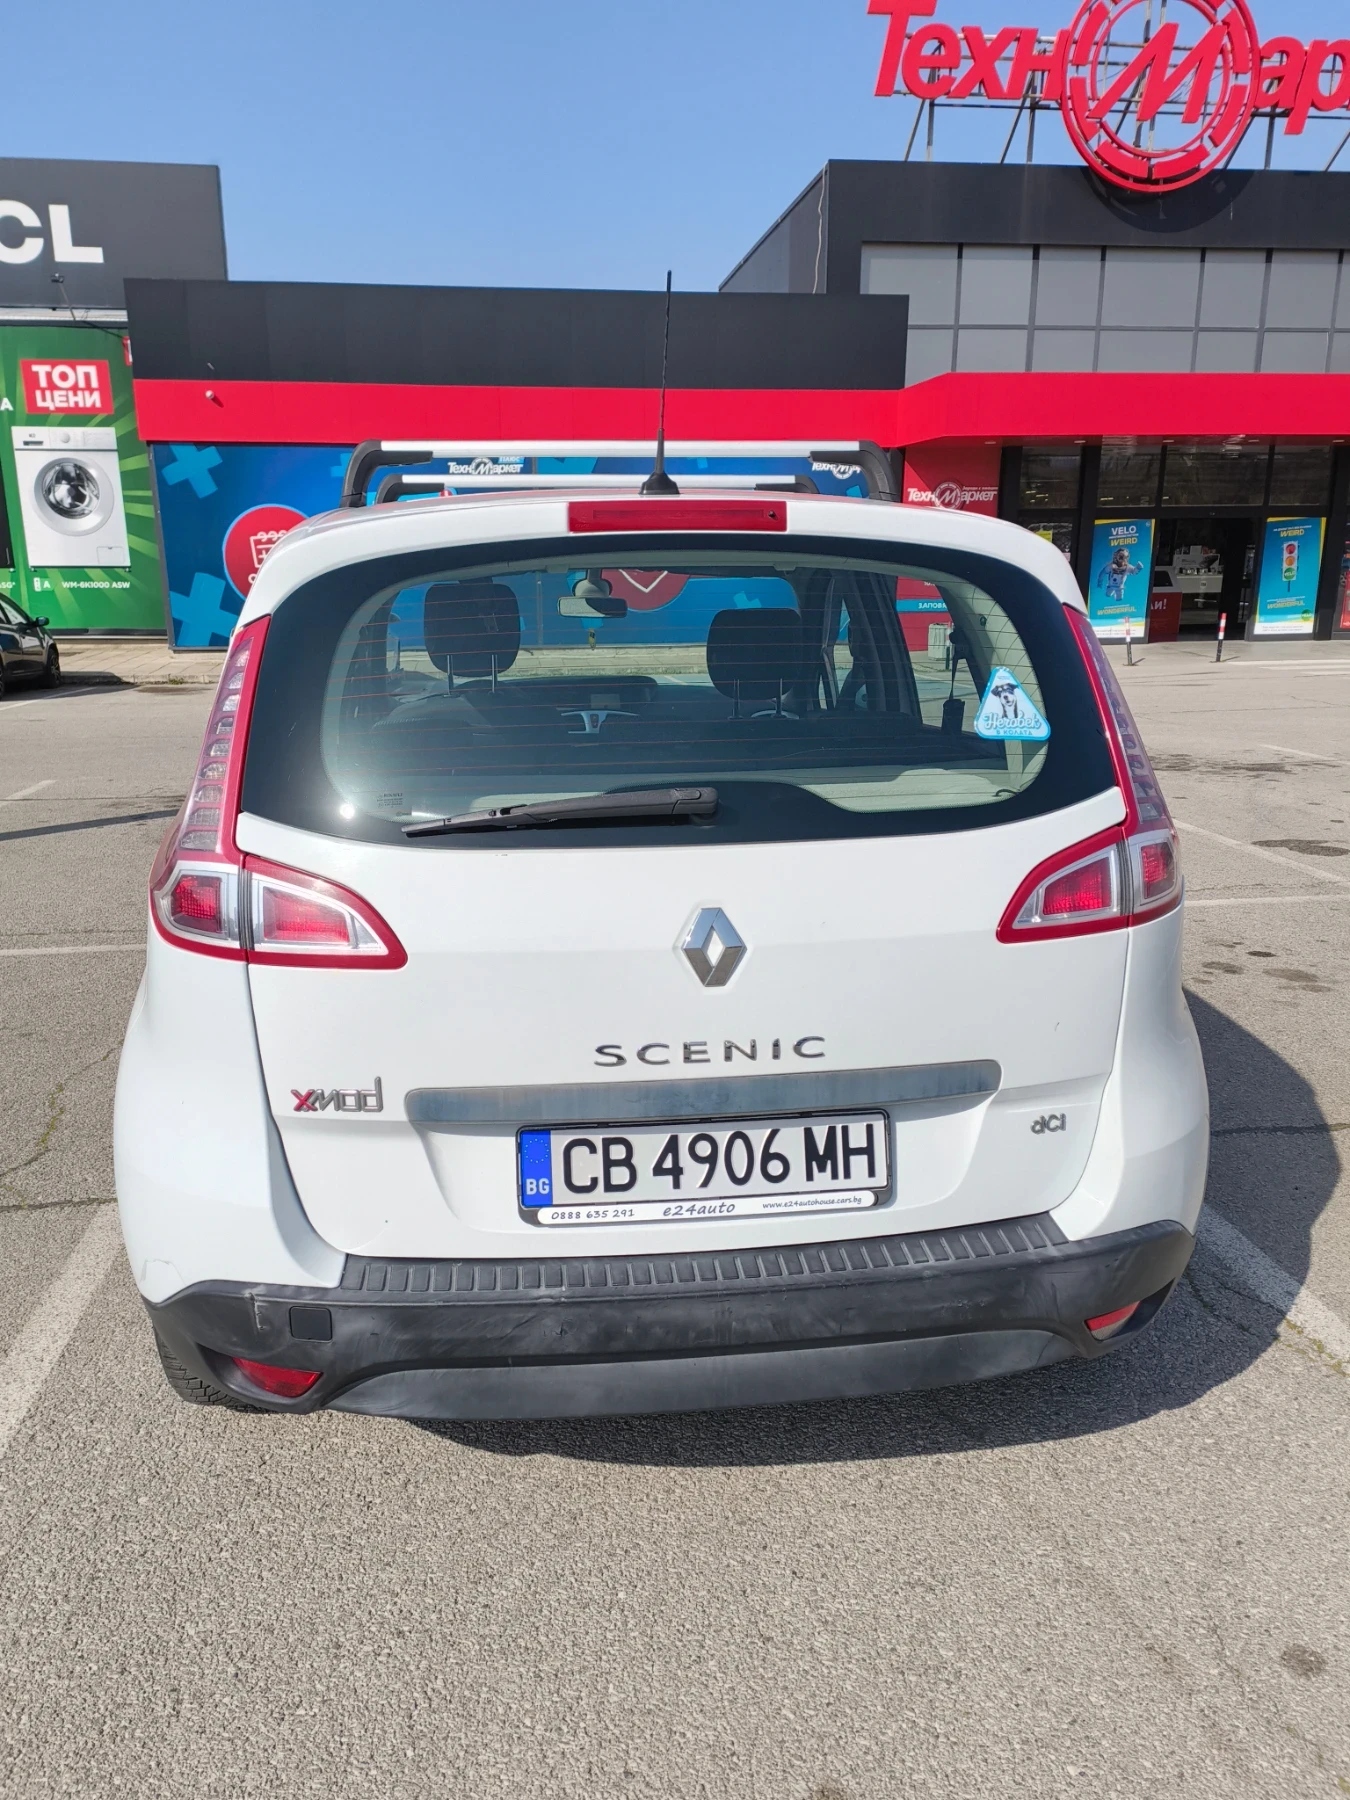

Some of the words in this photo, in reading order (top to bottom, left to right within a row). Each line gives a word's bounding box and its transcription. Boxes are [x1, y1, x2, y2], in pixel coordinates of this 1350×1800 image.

[31, 364, 99, 389] ТОП
[35, 389, 102, 411] ЦЕНИ
[1111, 525, 1137, 536] VELO
[1280, 529, 1305, 537] WEIRD
[1110, 537, 1138, 546] WEIRD
[61, 581, 110, 589] WM-6K1000
[111, 581, 131, 589] ASW
[1097, 606, 1136, 615] WONDERFUL
[593, 1035, 826, 1068] SCENIC
[563, 1136, 638, 1194] CB
[652, 1128, 790, 1190] 4906
[803, 1123, 876, 1182] MH
[525, 1178, 550, 1196] BG
[551, 1210, 581, 1220] 0888
[587, 1209, 609, 1219] 635
[612, 1207, 635, 1218] 291
[662, 1201, 736, 1217] e24auto
[762, 1194, 863, 1209] www.e24autohouse.cars.bg
